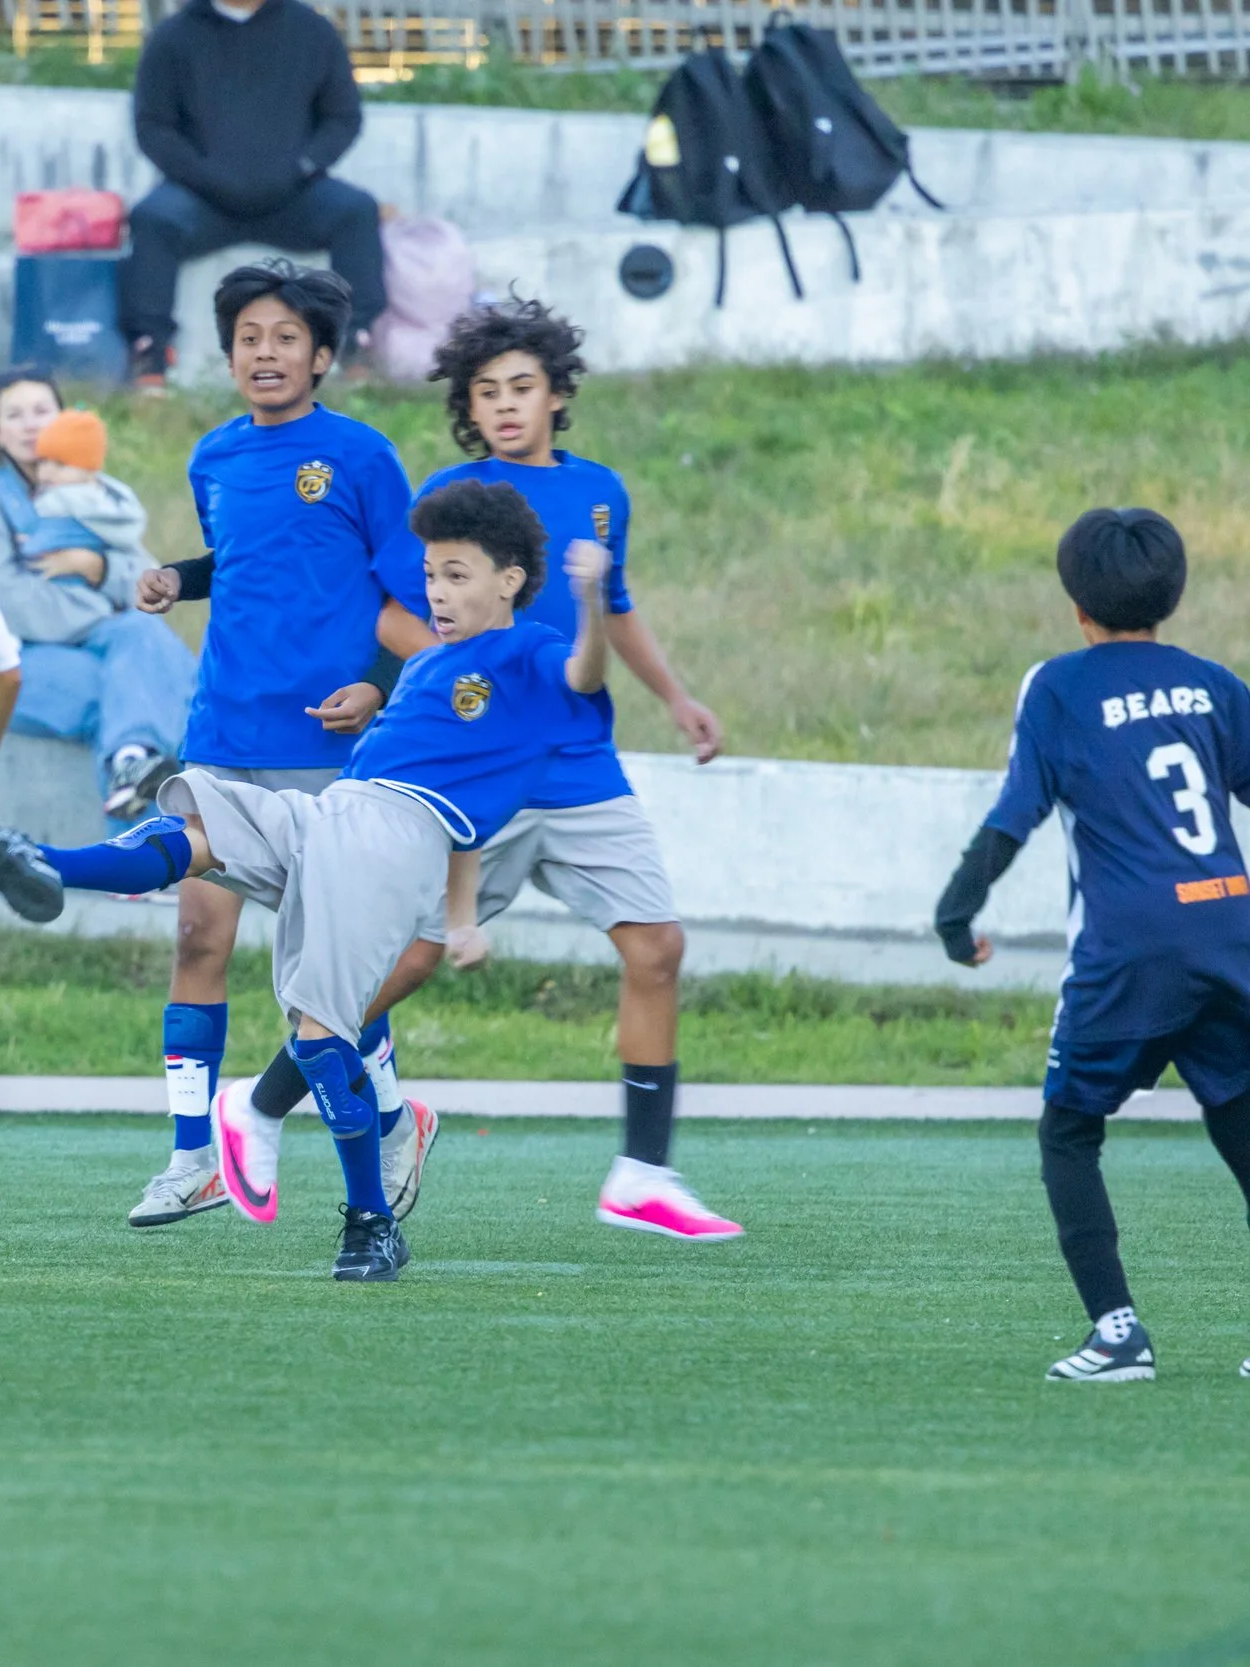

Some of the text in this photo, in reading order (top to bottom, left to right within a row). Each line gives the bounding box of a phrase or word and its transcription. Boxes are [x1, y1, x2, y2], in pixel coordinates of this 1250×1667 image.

[1101, 686, 1214, 730] BEARS
[1146, 741, 1218, 856] 3
[315, 1082, 337, 1121] SPORTS
